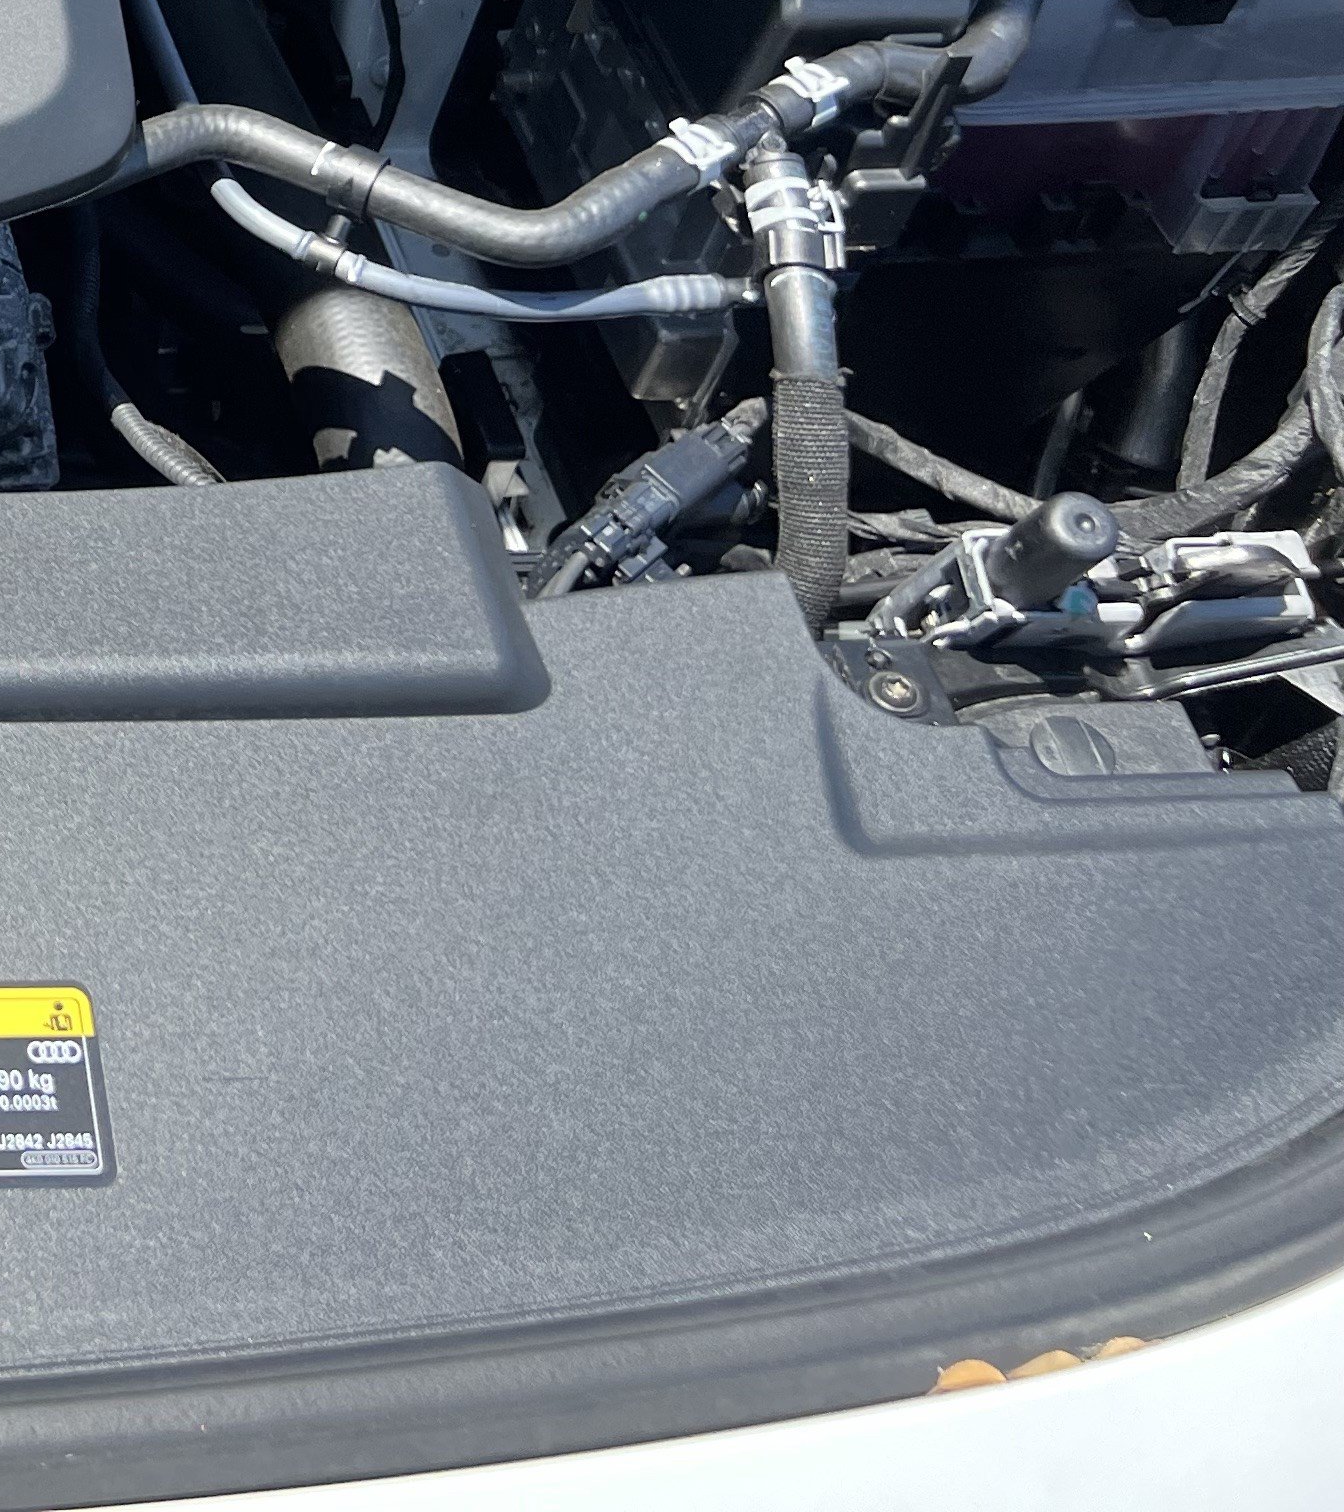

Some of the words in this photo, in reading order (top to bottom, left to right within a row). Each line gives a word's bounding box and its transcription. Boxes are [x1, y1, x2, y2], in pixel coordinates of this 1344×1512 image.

[28, 1068, 55, 1095] kg
[0, 1093, 59, 1112] 0.0003t
[47, 1131, 94, 1150] J2845
